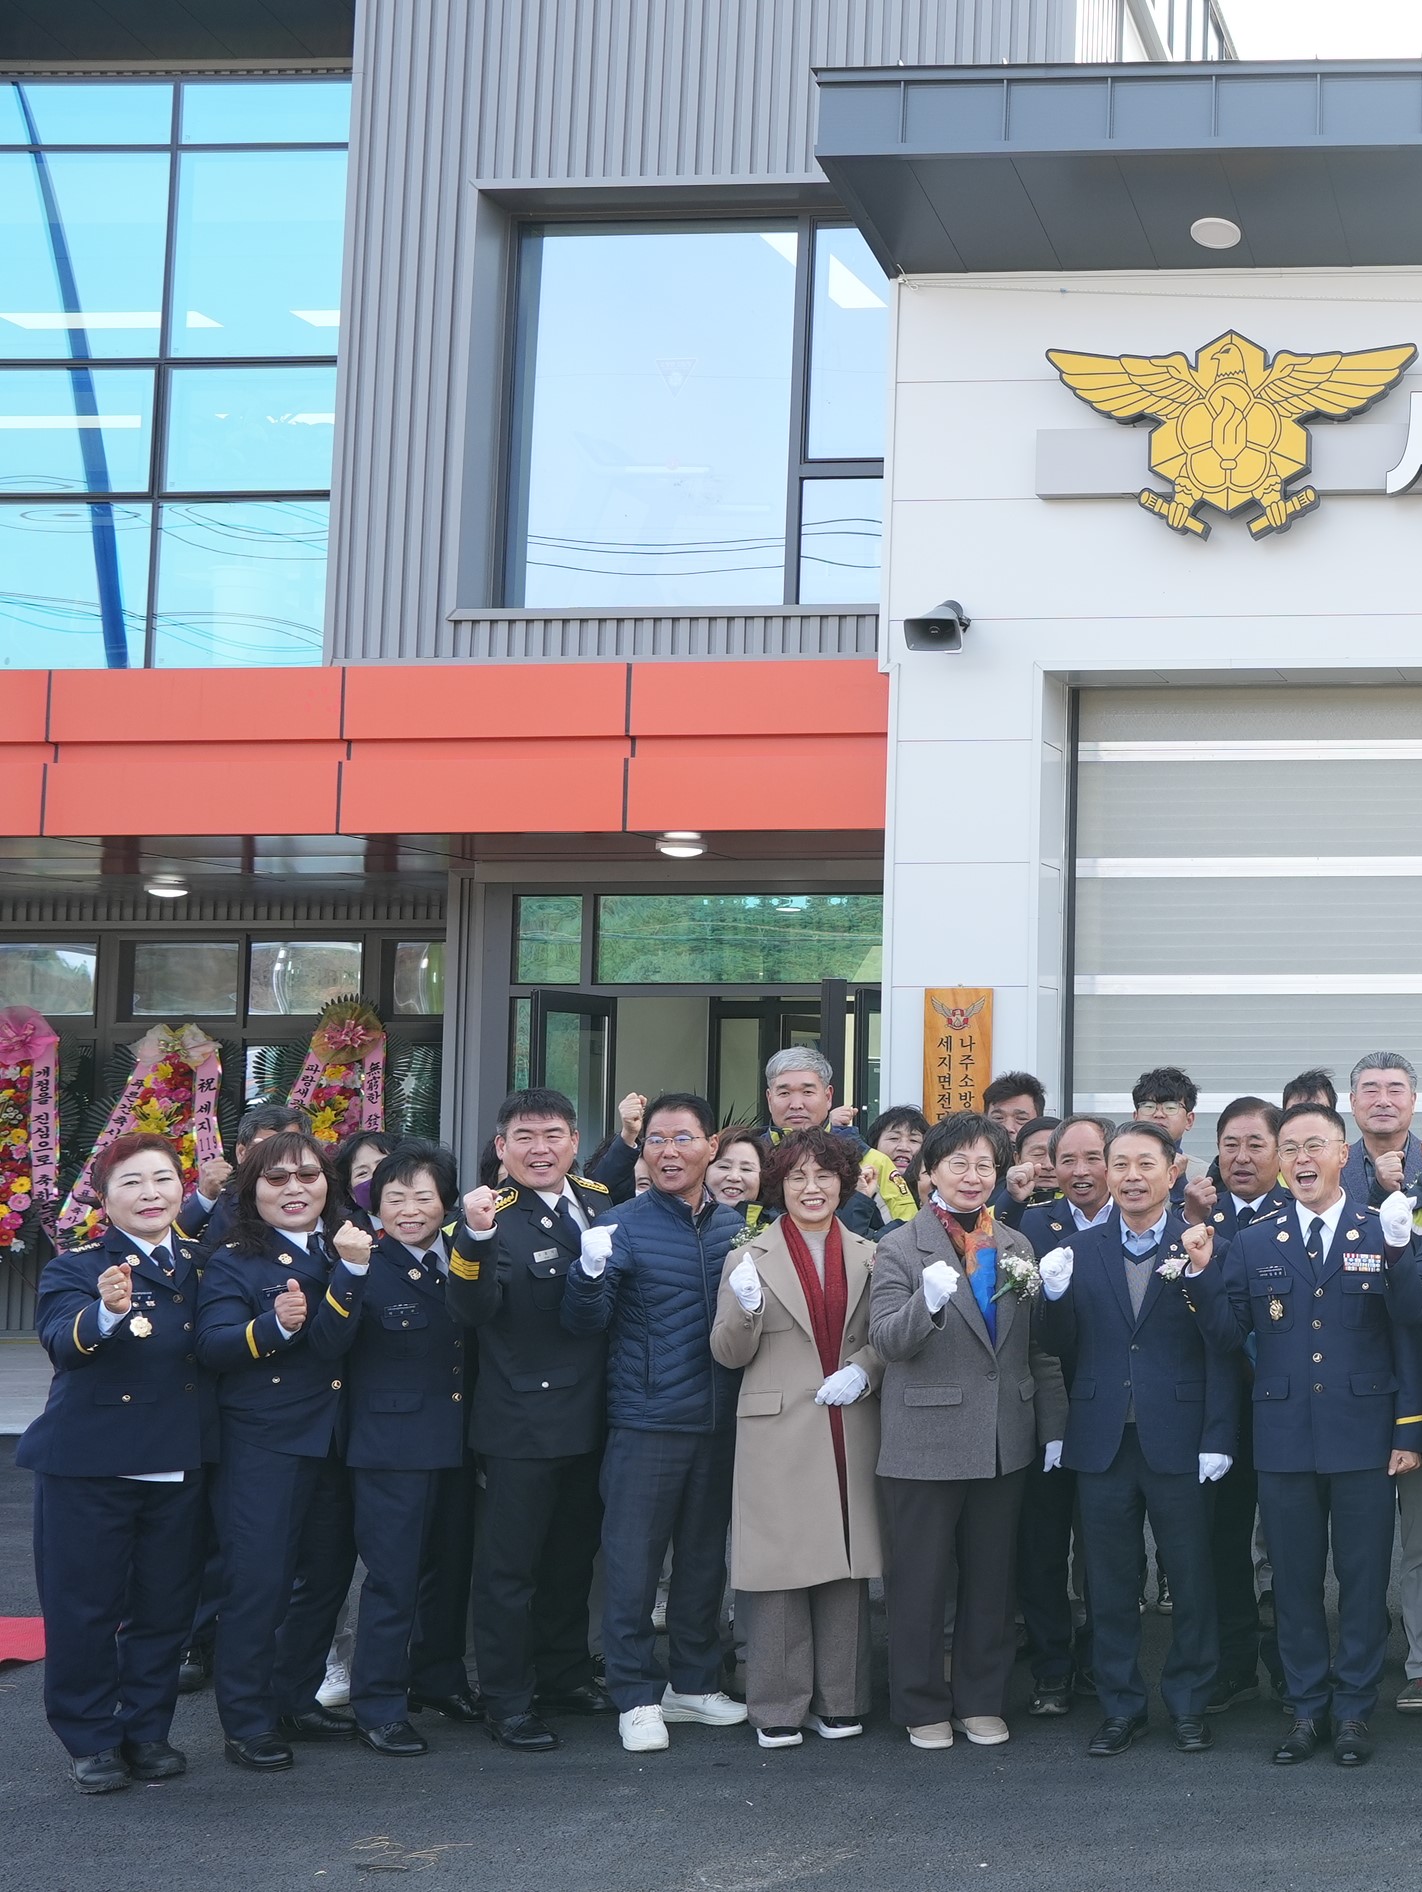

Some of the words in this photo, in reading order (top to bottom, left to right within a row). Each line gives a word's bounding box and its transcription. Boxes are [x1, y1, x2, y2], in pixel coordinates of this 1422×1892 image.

[198, 1077, 217, 1093] 祝
[958, 1035, 976, 1111] 나주소방
[32, 1112, 54, 1167] 진심으로
